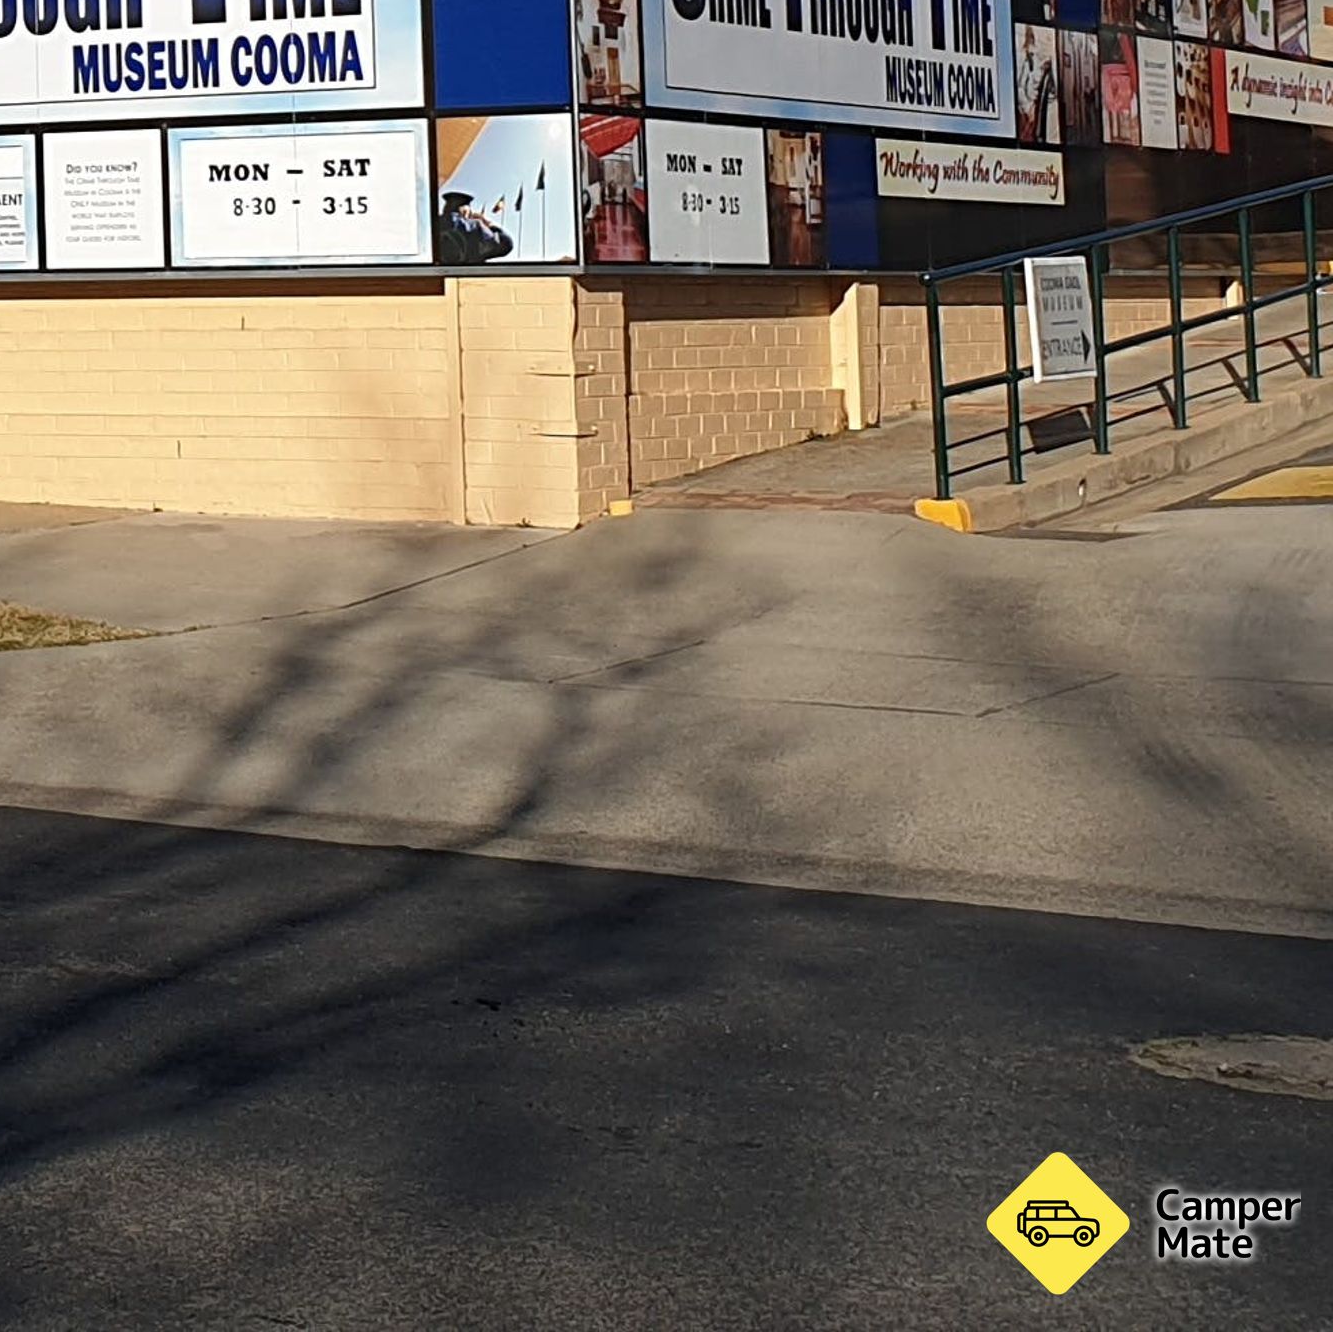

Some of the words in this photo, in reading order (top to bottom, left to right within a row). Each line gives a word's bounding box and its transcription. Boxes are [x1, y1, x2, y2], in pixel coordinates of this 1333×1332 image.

[73, 37, 220, 94] MUSEUM
[232, 29, 363, 87] COOMA
[886, 54, 944, 108] MUSEUM
[947, 62, 996, 114] COOMA
[1230, 66, 1240, 92] A
[84, 165, 103, 173] YOU
[105, 161, 138, 172] KNOW?
[207, 163, 270, 182] MON
[323, 158, 371, 177] SAT
[666, 153, 697, 174] MON
[879, 148, 939, 194] Working
[942, 153, 968, 182] with
[972, 153, 990, 185] the
[993, 159, 1060, 200] Community
